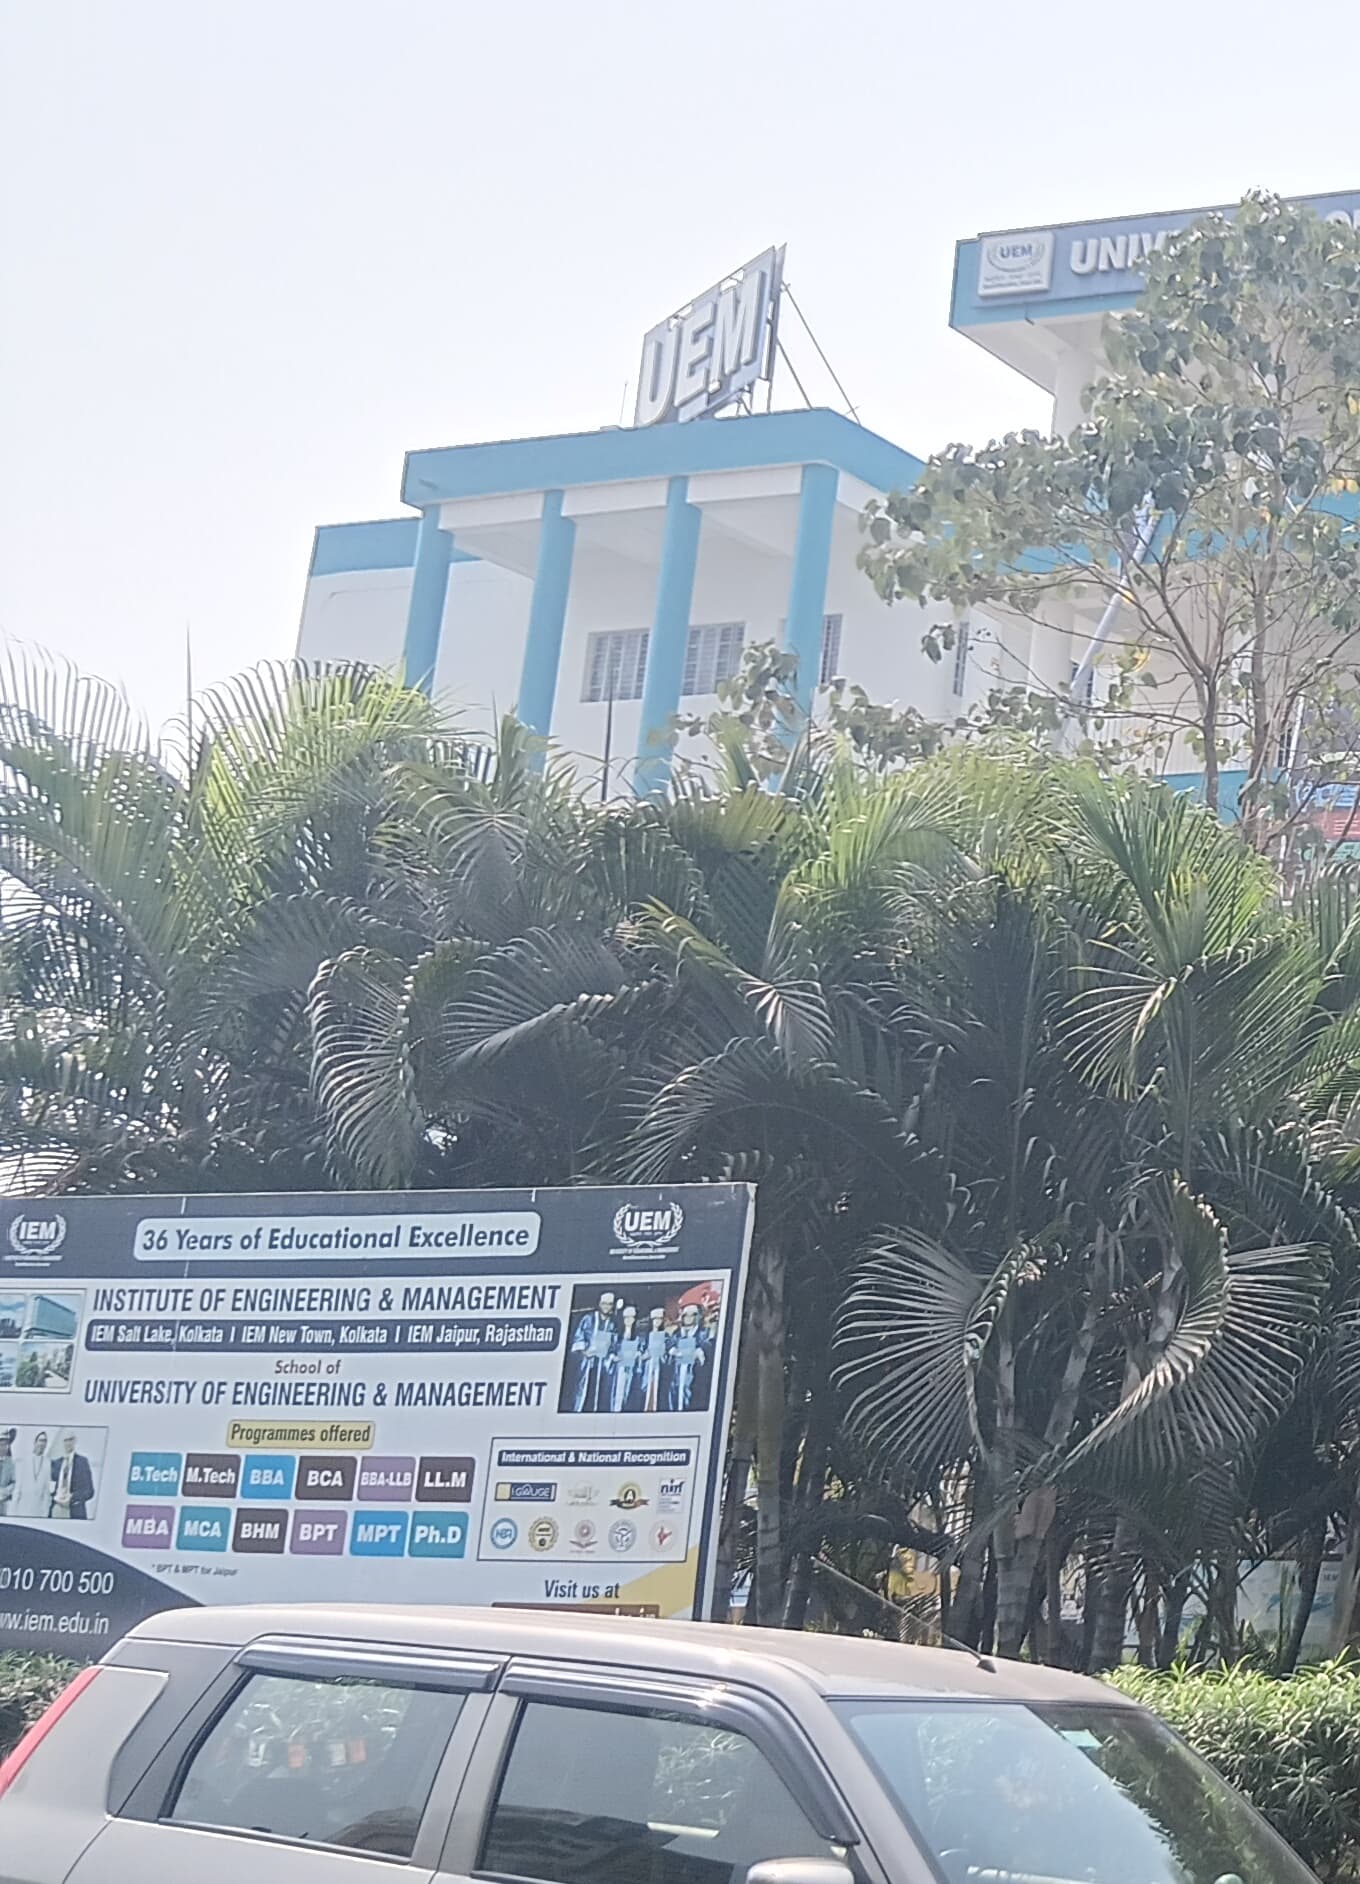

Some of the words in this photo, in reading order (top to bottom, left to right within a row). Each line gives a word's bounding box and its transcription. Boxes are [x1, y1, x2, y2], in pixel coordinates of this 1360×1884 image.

[634, 268, 769, 427] UEM
[18, 1220, 58, 1240] IEM
[624, 1209, 674, 1233] UEM
[142, 1229, 168, 1251] 36
[175, 1228, 233, 1251] Years
[240, 1227, 263, 1250] of
[267, 1225, 401, 1250] Educational
[408, 1223, 530, 1249] Excellence
[92, 1287, 194, 1312] INSTITUTE
[199, 1287, 226, 1312] OF
[230, 1286, 372, 1312] ENGINEERING
[377, 1288, 394, 1311] &
[401, 1284, 562, 1311] MANAGEMENT
[91, 1323, 114, 1343] IEM
[178, 1323, 223, 1344] Kolkata
[241, 1324, 266, 1344] IEM
[268, 1324, 297, 1344] New
[300, 1324, 336, 1348] Town,
[339, 1323, 388, 1344] Kolkata
[407, 1326, 433, 1344] IEM
[435, 1325, 482, 1348] Jaipur,
[485, 1324, 554, 1346] Rajasthan
[274, 1359, 323, 1375] School
[326, 1359, 342, 1374] of
[84, 1380, 197, 1406] UNIVERSITY
[201, 1381, 227, 1406] OF
[231, 1381, 367, 1407] ENGINEERING
[372, 1383, 388, 1407] &
[394, 1381, 548, 1408] MANAGEMENT
[230, 1424, 316, 1445] Programmes
[320, 1424, 372, 1443] offered
[500, 1450, 566, 1466] International
[567, 1451, 576, 1464] &
[578, 1450, 621, 1465] National
[623, 1450, 687, 1467] Recognition
[130, 1464, 179, 1484] B.Tech
[186, 1466, 236, 1486] M.Tech
[250, 1468, 285, 1486] BBA
[306, 1470, 344, 1488] BCA
[423, 1470, 467, 1488] LL.M
[126, 1518, 170, 1538] MBA
[183, 1519, 223, 1539] MCA
[240, 1522, 280, 1541] BHM
[299, 1523, 339, 1542] BPT
[356, 1524, 402, 1544] MPT
[414, 1525, 462, 1545] Ph.D
[39, 1569, 74, 1593] 700
[78, 1571, 115, 1595] 500
[544, 1579, 578, 1599] Visit
[582, 1584, 601, 1599] us
[604, 1582, 621, 1599] at
